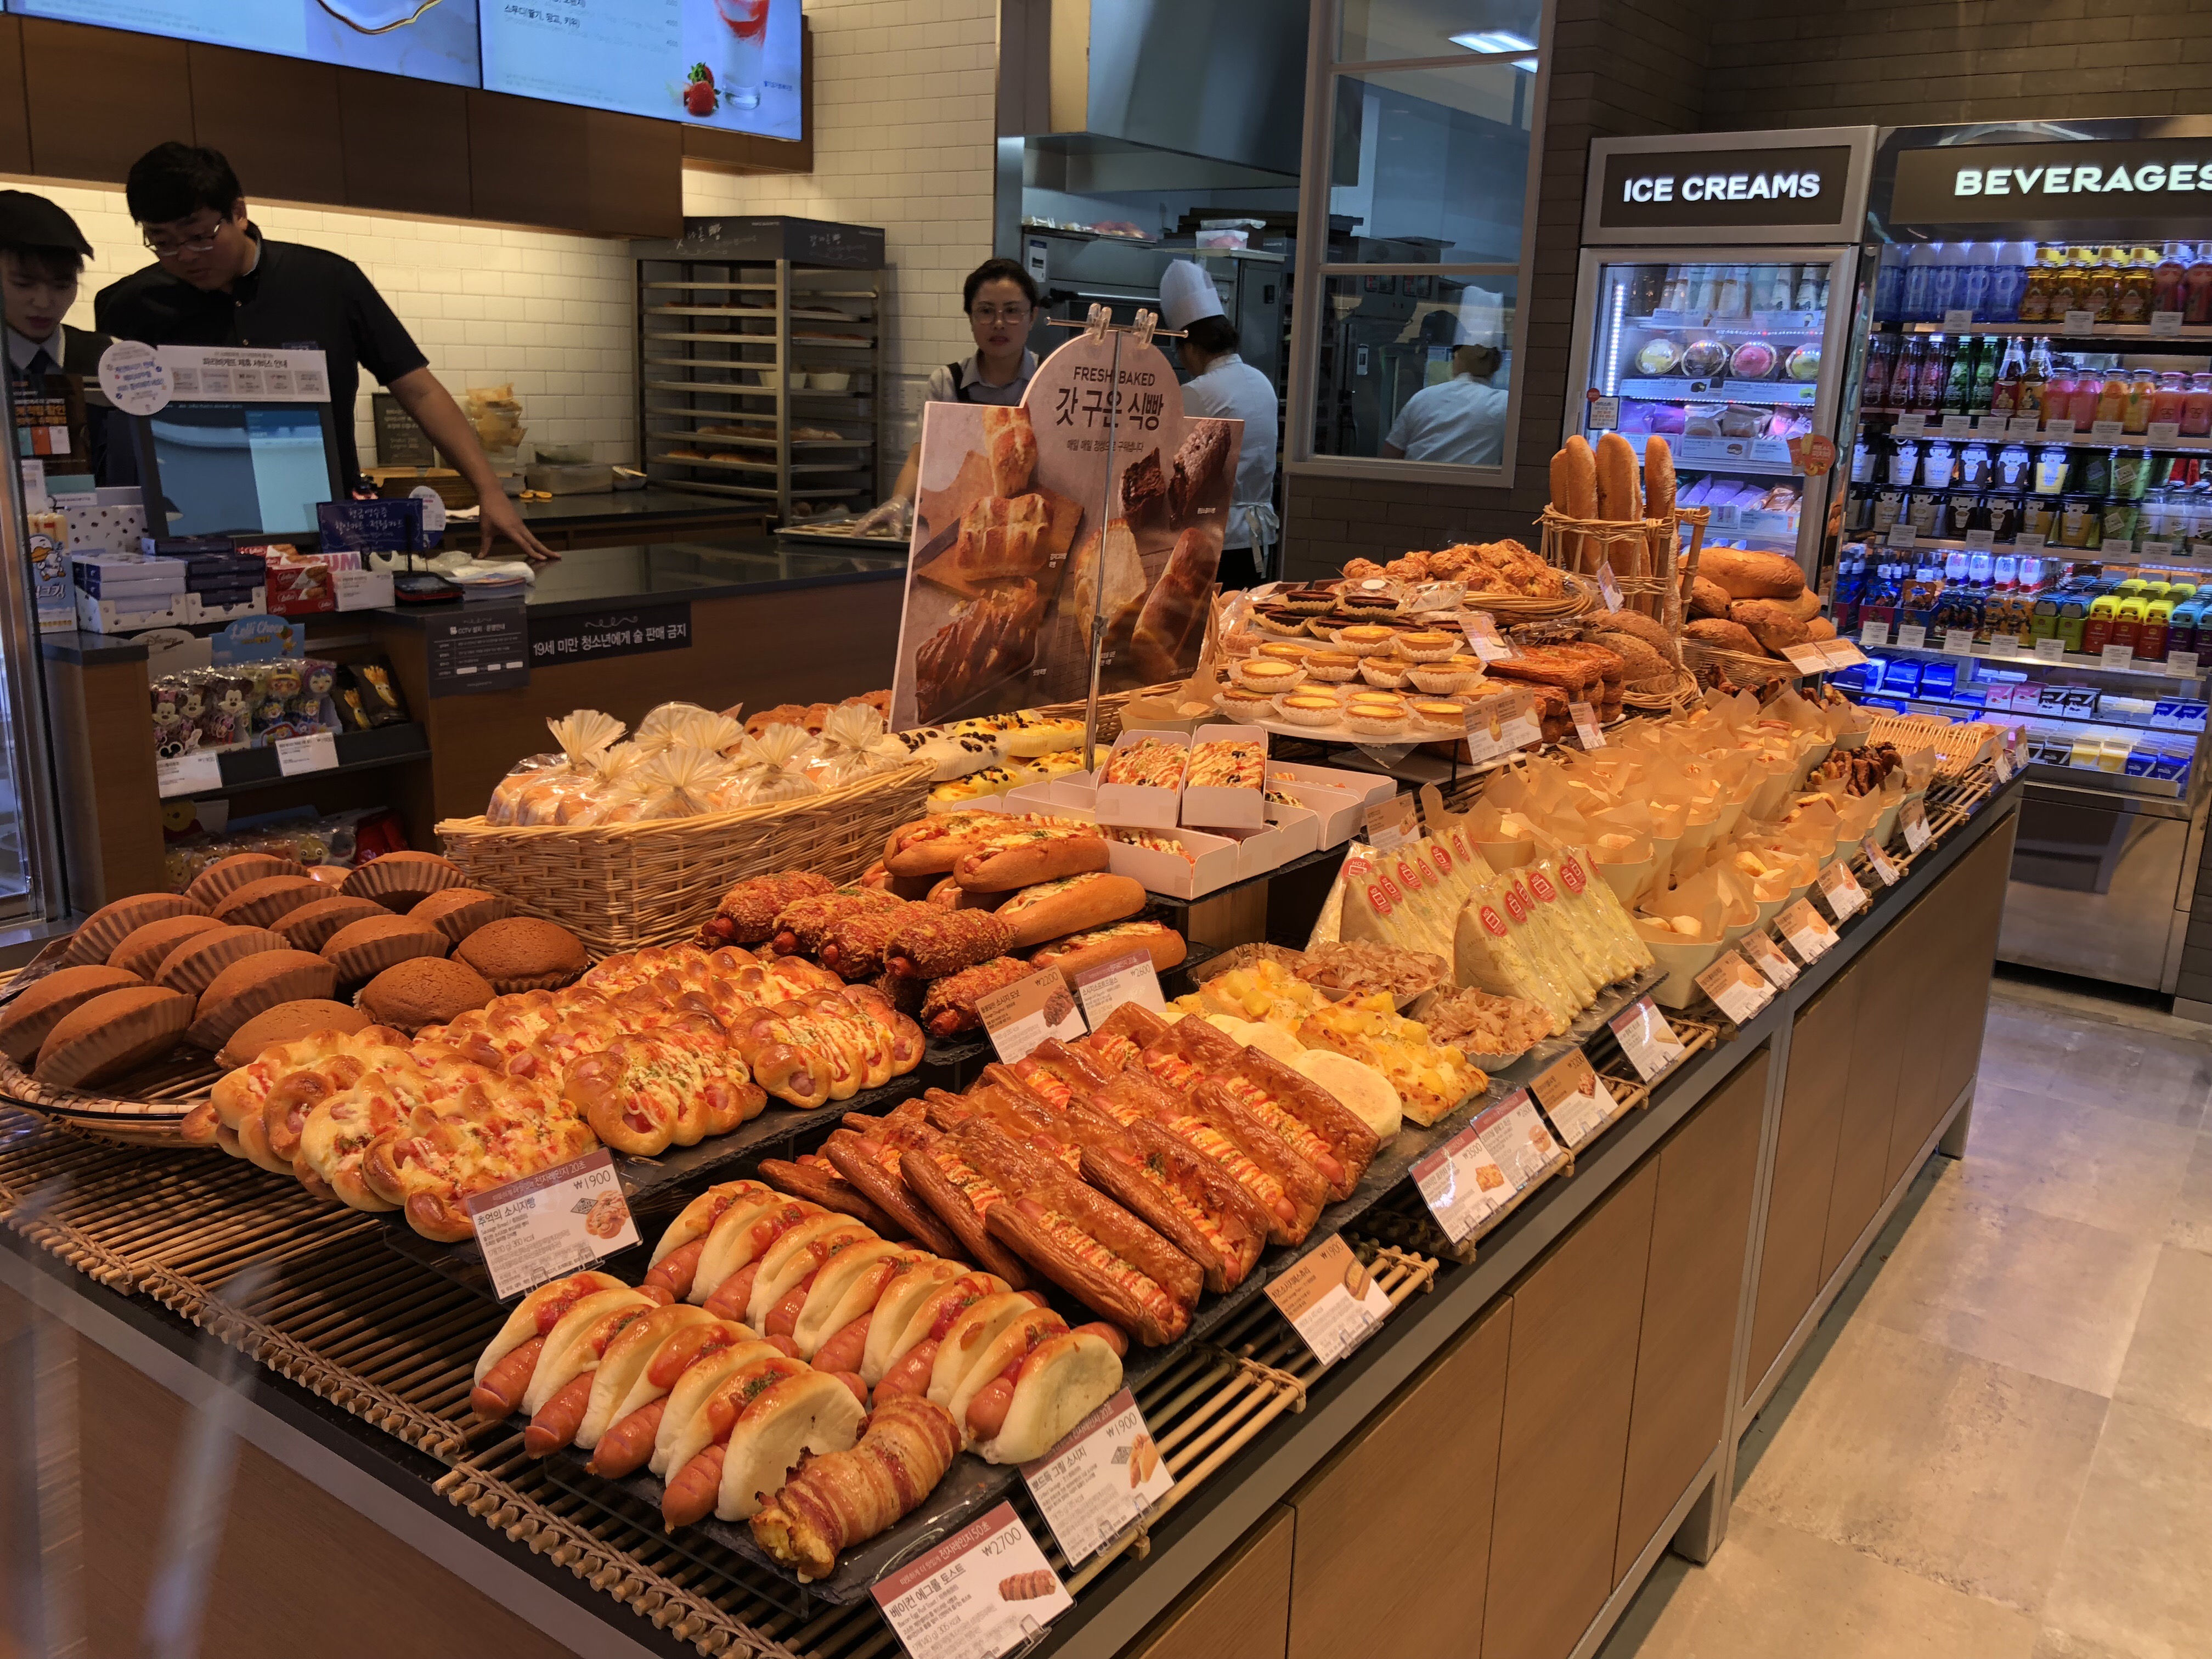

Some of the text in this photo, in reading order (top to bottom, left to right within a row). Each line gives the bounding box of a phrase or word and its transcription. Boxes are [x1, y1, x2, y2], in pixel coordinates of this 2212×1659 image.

[1623, 173, 1821, 202] ICE CREAMS
[1954, 165, 2212, 196] BEVERAGES
[1073, 366, 1156, 386] FRESH BAKED
[1056, 387, 1079, 426] 갓
[1127, 393, 1164, 431] 식빵
[533, 623, 686, 656] 19세 미만 청소년에게 술 판매 금지
[1482, 909, 1491, 917] HOT
[1035, 972, 1058, 988] ₩2200
[995, 990, 1020, 1006] 소시지 도넛
[1462, 1142, 1483, 1161] ₩3500
[535, 1166, 568, 1186] 전자레인지
[568, 1160, 586, 1172] 20초
[574, 1170, 611, 1192] ₩1900
[477, 1197, 536, 1227] 추억의 소시지빵
[1319, 1240, 1344, 1261] ₩1900
[1106, 1412, 1138, 1441] ₩1900
[1051, 1461, 1066, 1477] 그릴
[1065, 1446, 1086, 1466] 소시지
[939, 1532, 974, 1559] 전자레인지
[970, 1521, 991, 1538] 50초
[981, 1527, 1023, 1559] ₩2700
[888, 1595, 917, 1619] 베이컨
[913, 1578, 943, 1601] 에그롤
[939, 1562, 966, 1584] 토스트
[897, 1616, 911, 1628] Bacon
[910, 1611, 920, 1620] Egg
[947, 1614, 961, 1626] kcal
